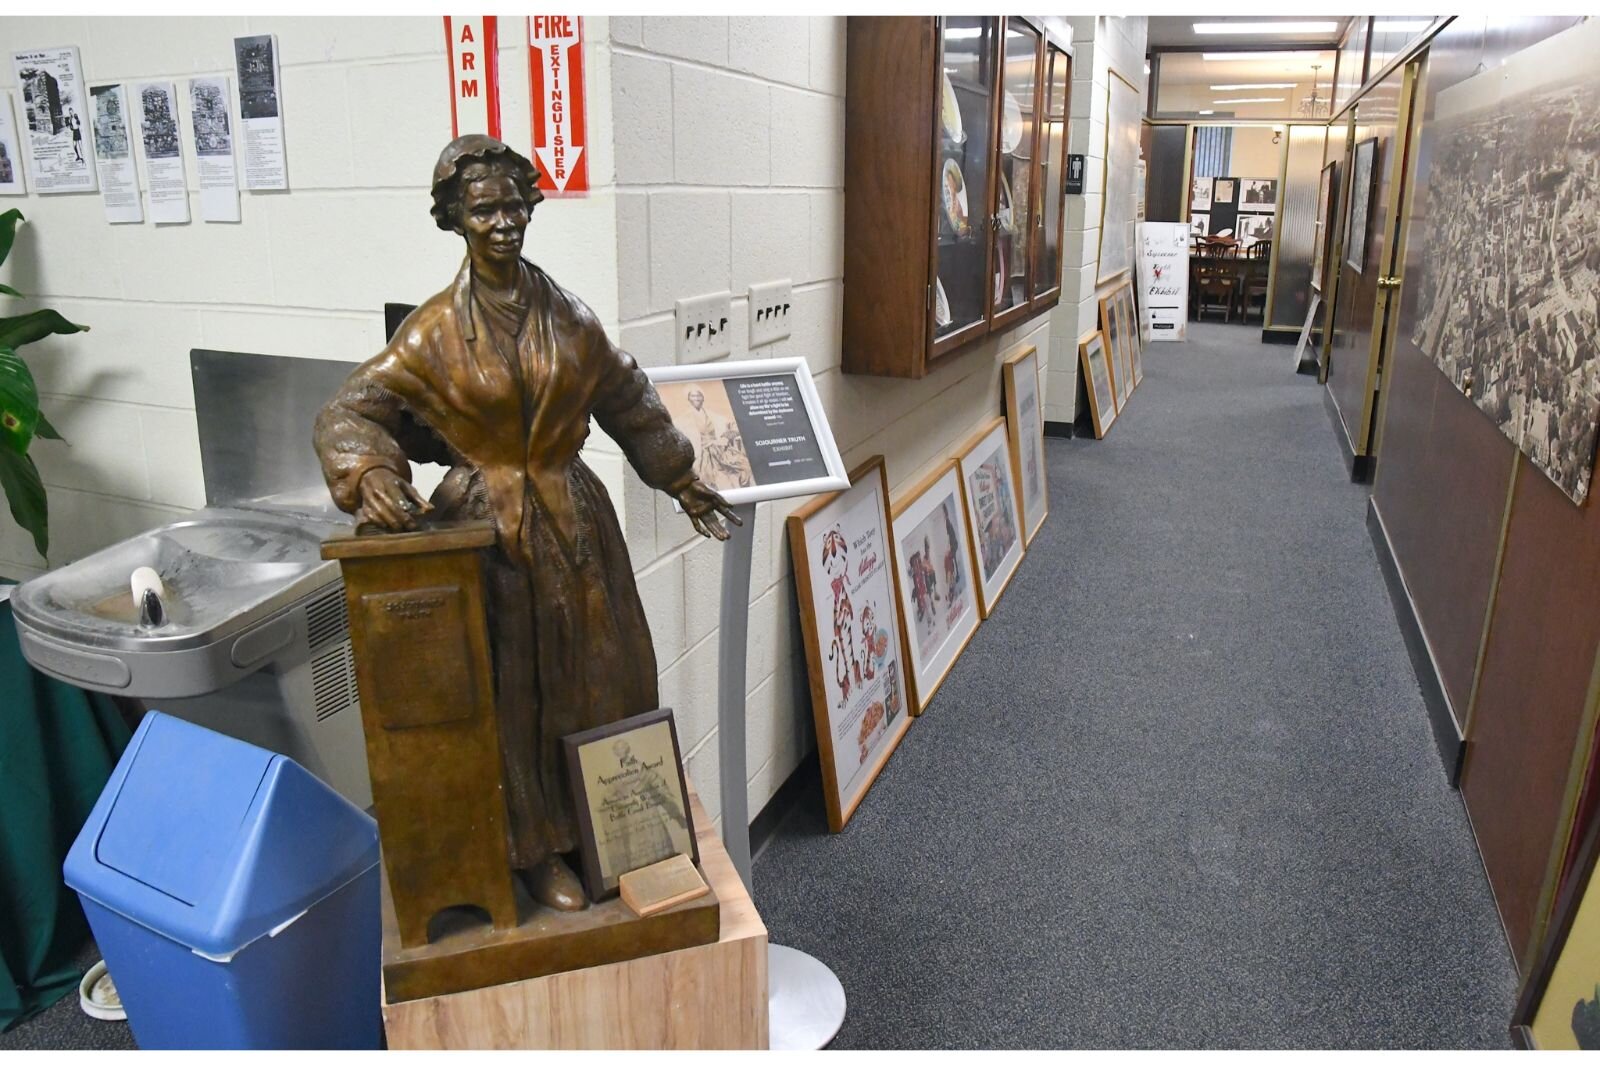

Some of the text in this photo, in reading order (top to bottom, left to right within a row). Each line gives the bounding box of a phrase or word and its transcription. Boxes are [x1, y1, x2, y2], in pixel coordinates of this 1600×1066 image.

[534, 16, 573, 39] FIRE
[551, 45, 565, 179] EXTINGUISHER
[755, 437, 787, 446] SOJOURNER
